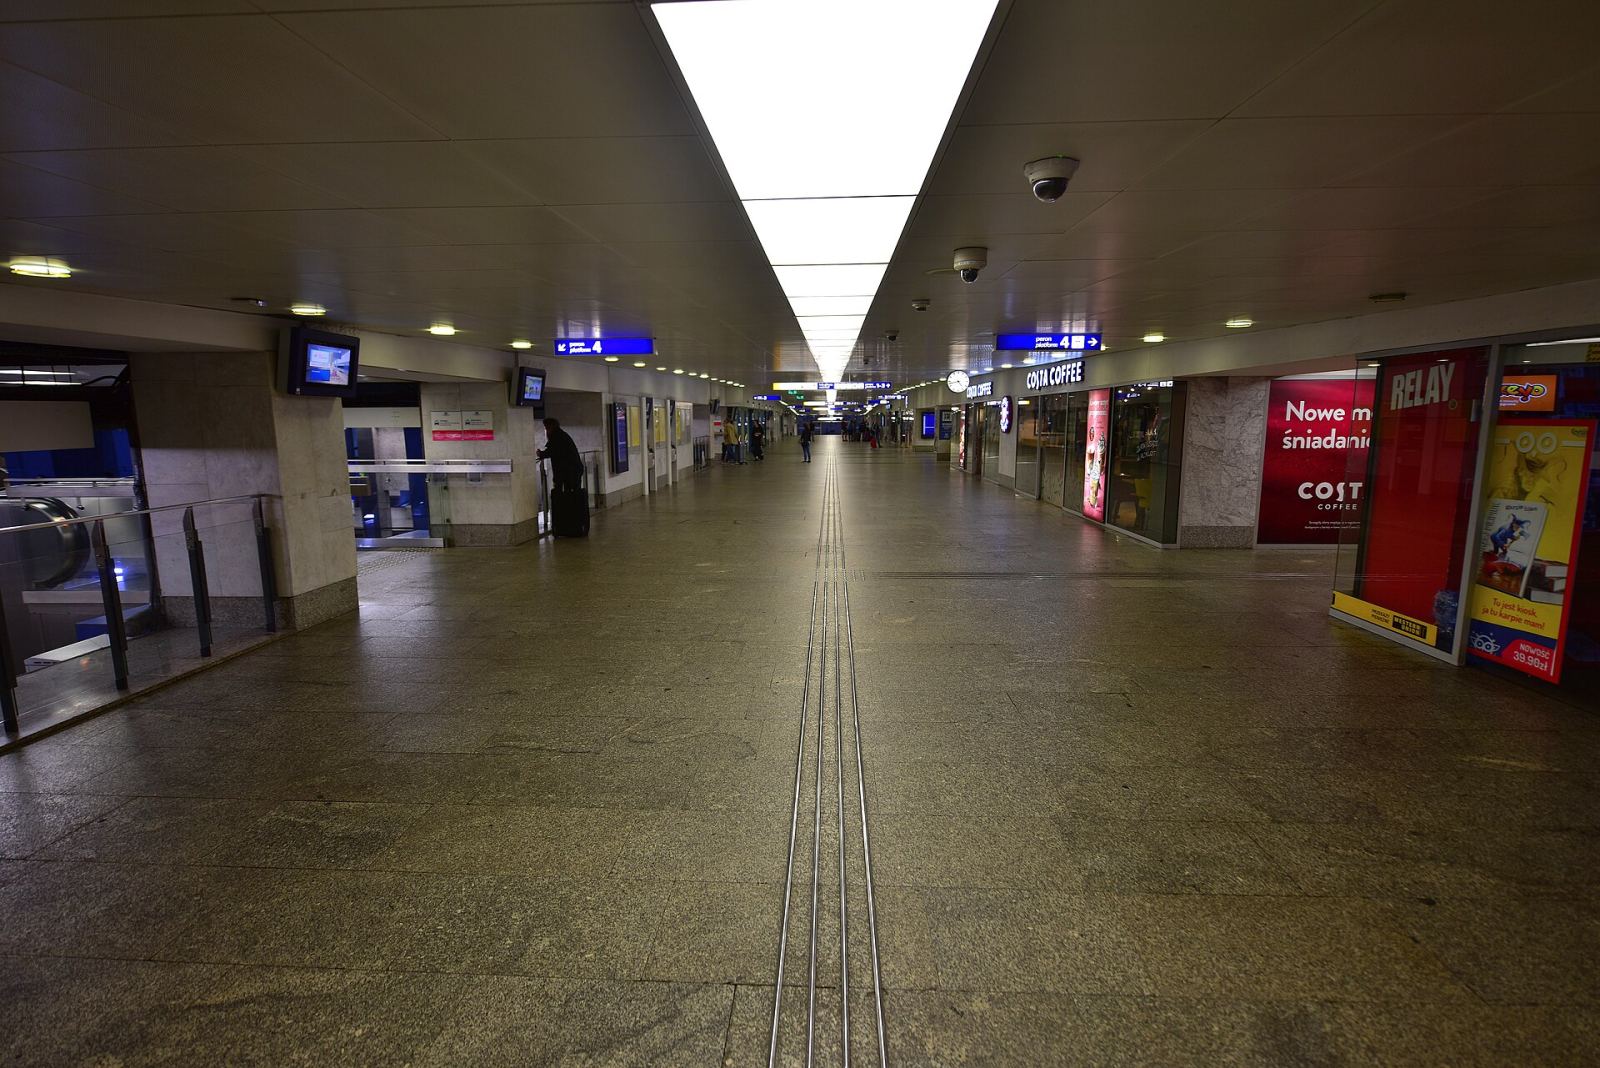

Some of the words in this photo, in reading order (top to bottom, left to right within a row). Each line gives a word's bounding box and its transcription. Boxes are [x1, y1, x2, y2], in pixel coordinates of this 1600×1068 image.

[592, 340, 602, 353] 4
[1059, 336, 1070, 348] 4
[1026, 368, 1049, 390] COSTA
[1049, 361, 1082, 386] COFFEE
[1390, 362, 1456, 411] RELAY
[1285, 400, 1346, 422] Nowe
[1352, 408, 1373, 421] m
[1297, 482, 1364, 502] COST
[1394, 616, 1421, 630] WESTERN
[1401, 624, 1421, 637] UNION
